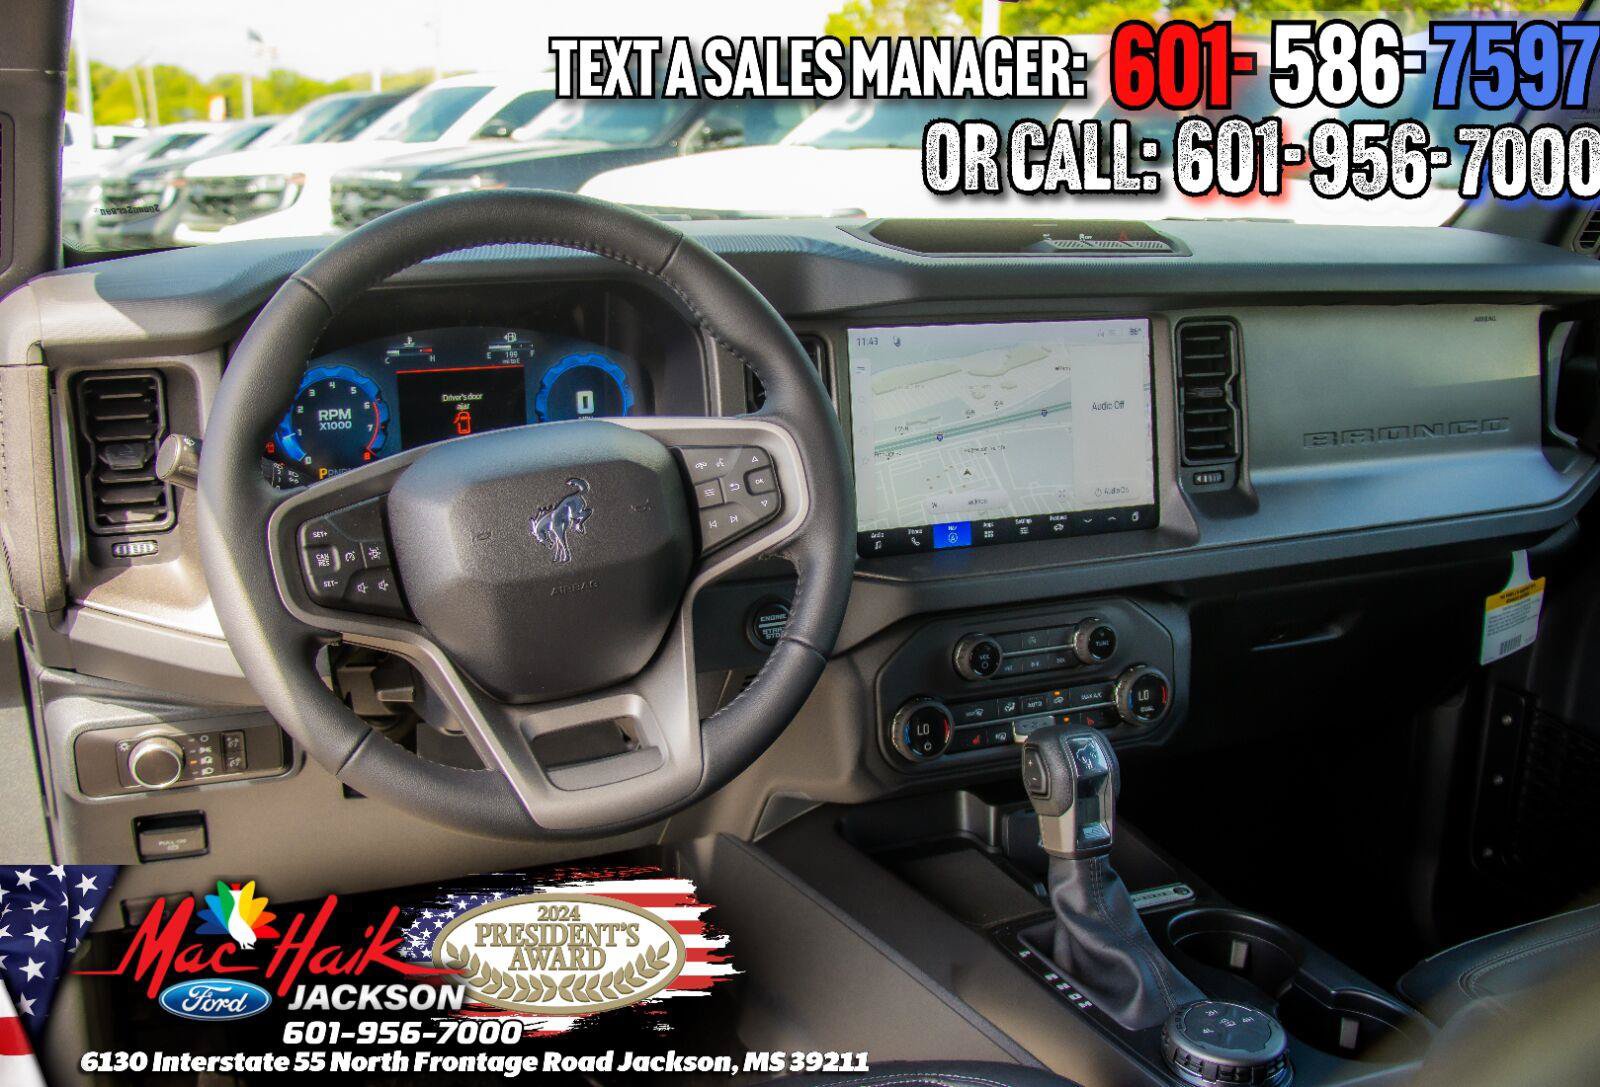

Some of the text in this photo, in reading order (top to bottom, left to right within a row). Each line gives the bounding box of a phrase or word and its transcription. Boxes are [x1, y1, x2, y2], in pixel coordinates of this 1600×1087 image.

[329, 381, 336, 389] 4
[350, 386, 357, 394] 5
[308, 389, 316, 397] 3
[577, 391, 594, 414] 0
[1092, 400, 1125, 411] Audio Off
[318, 408, 352, 421] RPM
[1303, 417, 1510, 449] BRONCO
[550, 580, 600, 596] AIRBAG
